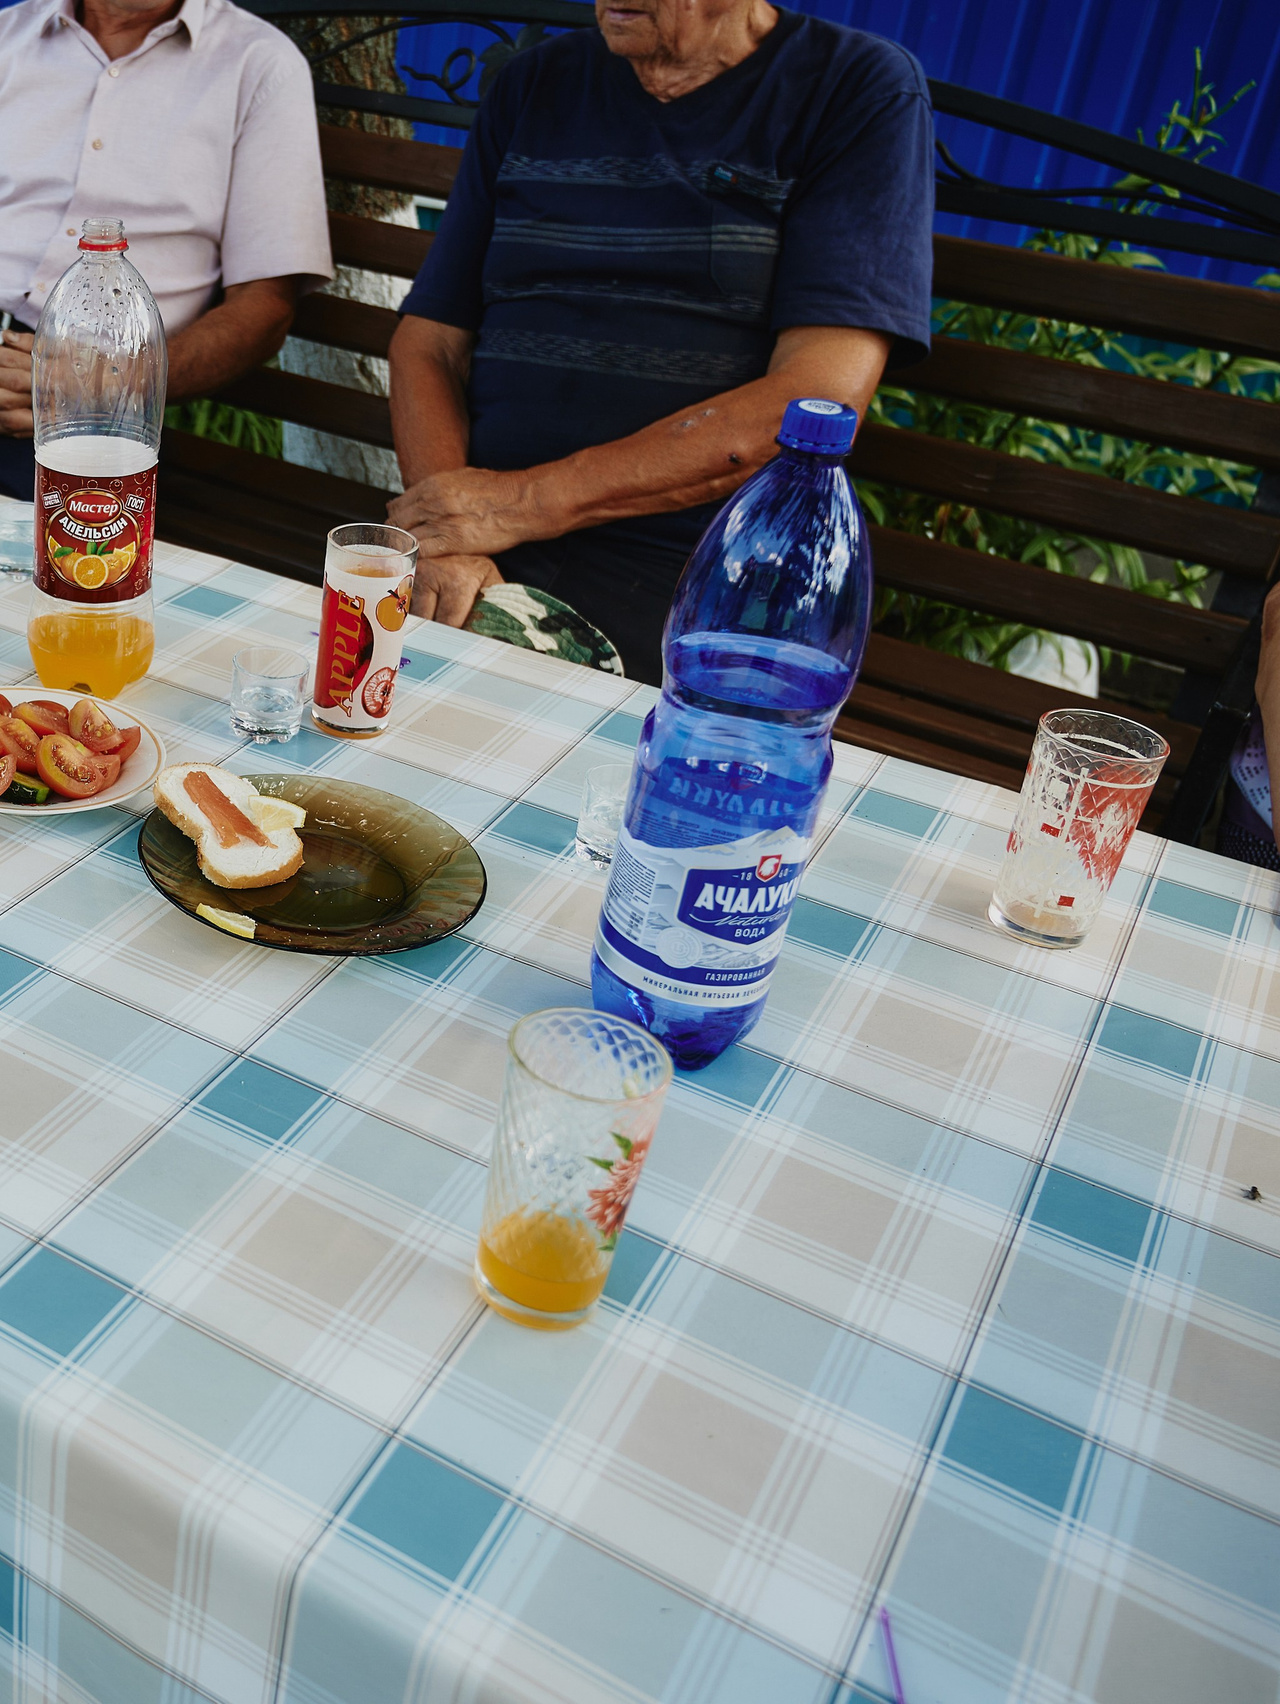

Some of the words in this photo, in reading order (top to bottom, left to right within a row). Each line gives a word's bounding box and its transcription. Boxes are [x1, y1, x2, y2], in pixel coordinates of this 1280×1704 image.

[69, 500, 119, 516] Мастер
[127, 496, 144, 510] ГОСТ
[59, 516, 128, 539] АПЕЛЬСИН
[328, 589, 365, 718] APPLE
[734, 927, 765, 938] ВОДА
[705, 967, 765, 981] ГАЗИРОВАННАЯ
[642, 976, 699, 998] МИНЕРАЛЬНАЯ
